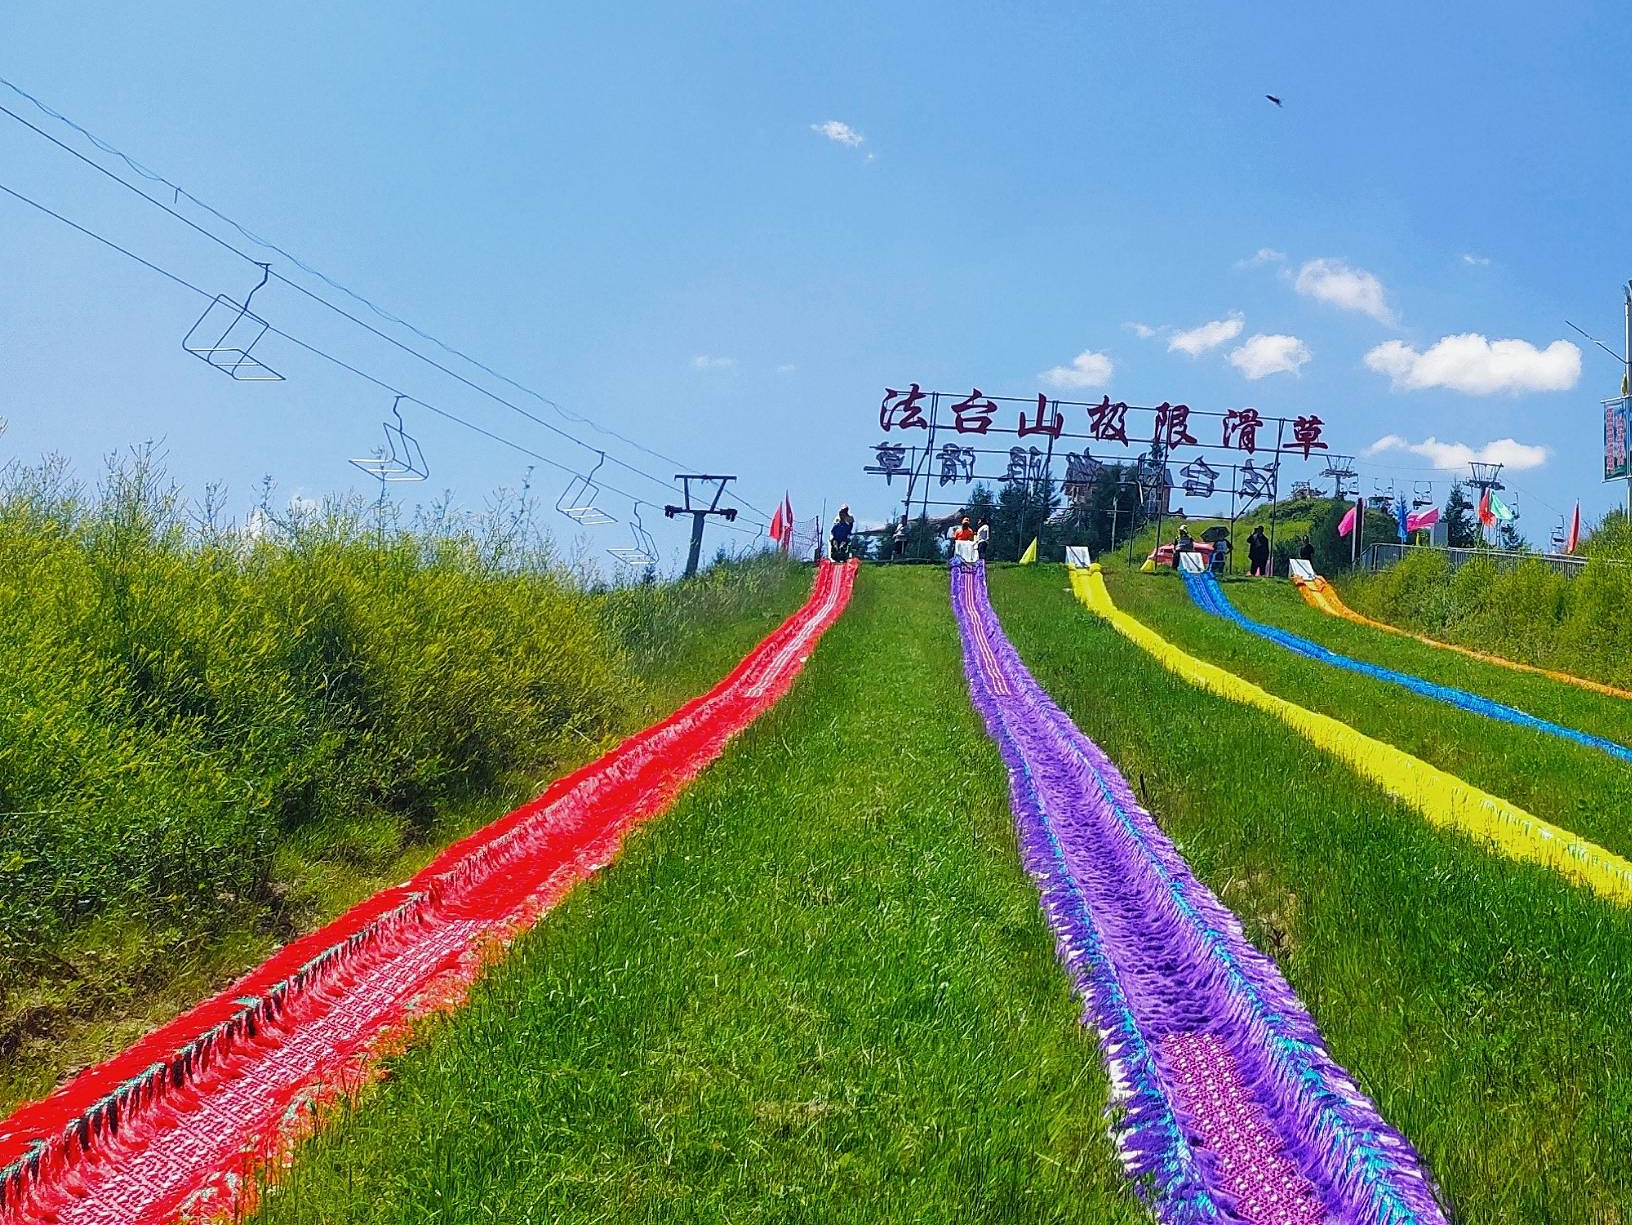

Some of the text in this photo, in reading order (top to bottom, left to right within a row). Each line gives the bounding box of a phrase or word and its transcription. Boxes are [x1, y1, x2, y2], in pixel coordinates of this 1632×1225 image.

[880, 383, 1329, 461] 法台山极限滑草
